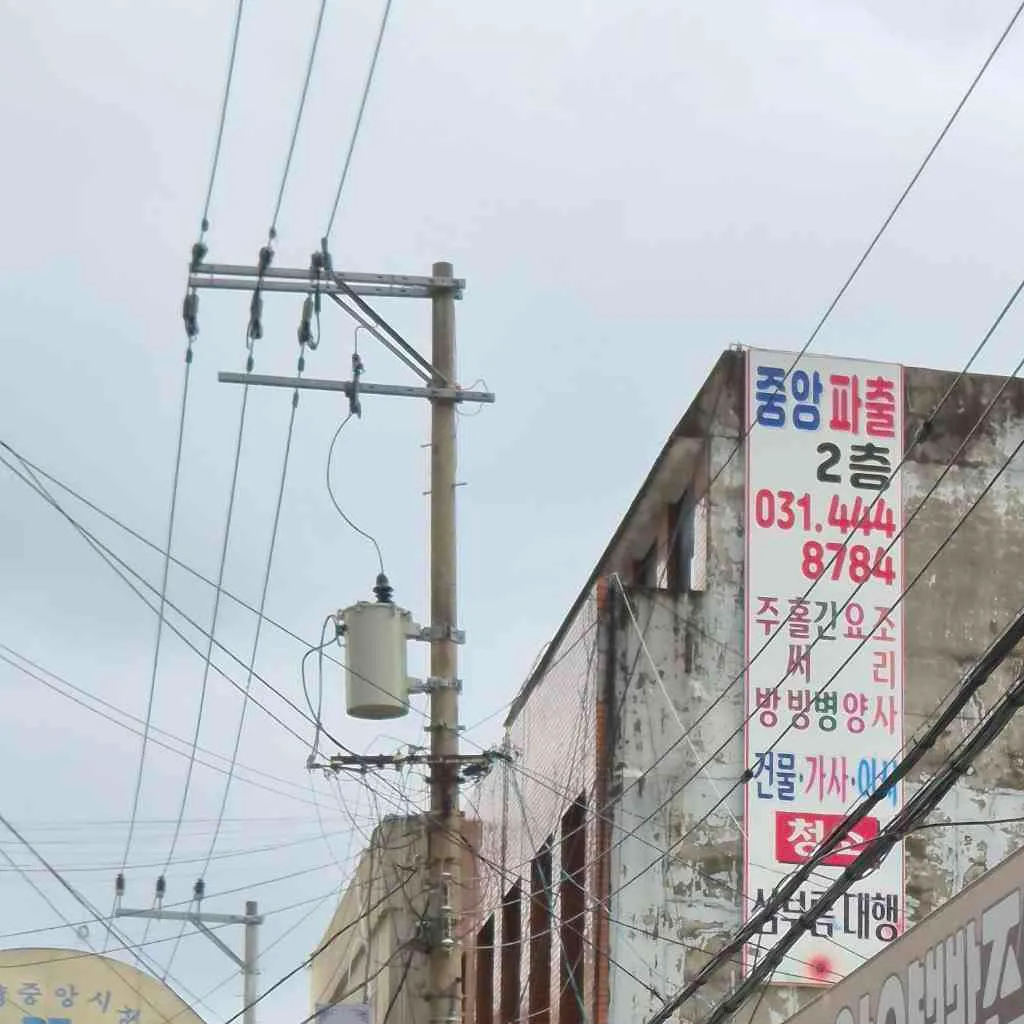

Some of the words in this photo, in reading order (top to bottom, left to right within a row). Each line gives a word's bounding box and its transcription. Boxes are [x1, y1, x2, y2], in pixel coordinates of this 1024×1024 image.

[817, 442, 891, 492] 2층
[755, 489, 896, 538] 031.444
[801, 541, 896, 586] 8784
[843, 892, 899, 942] 대행
